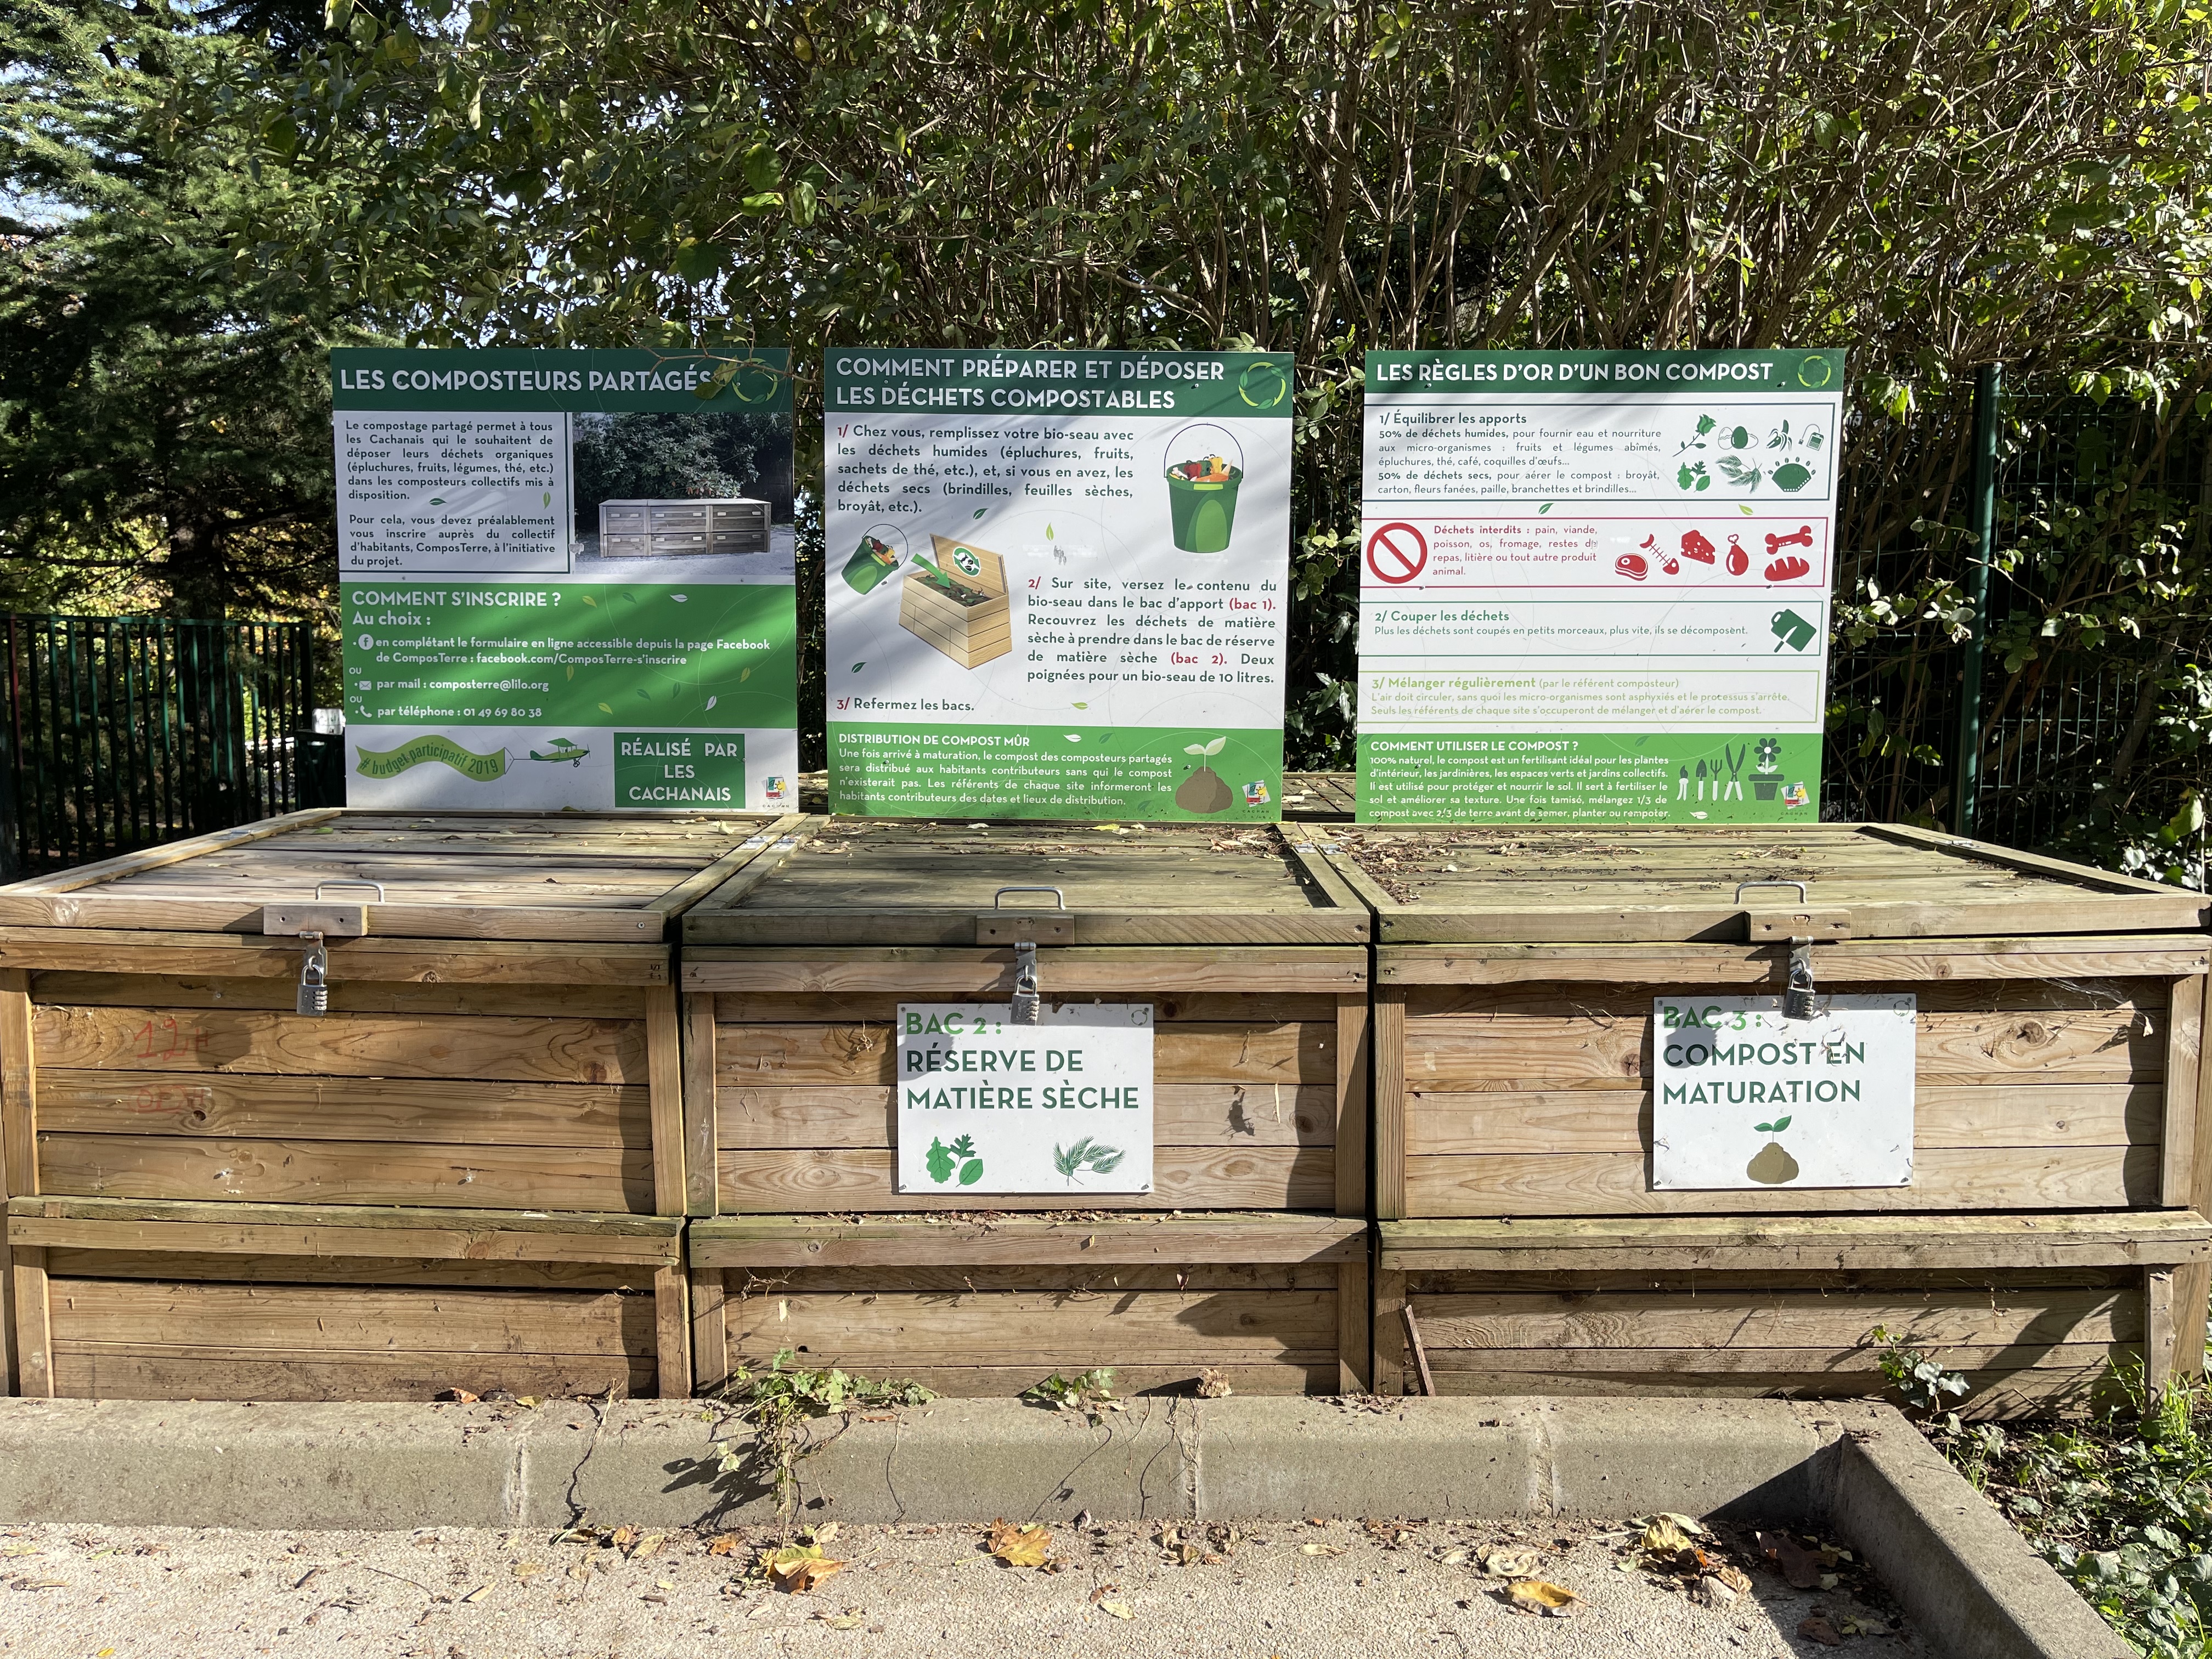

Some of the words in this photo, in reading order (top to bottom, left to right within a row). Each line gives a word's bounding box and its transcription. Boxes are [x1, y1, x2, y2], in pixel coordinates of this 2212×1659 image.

[836, 358, 955, 377] COMMENT
[963, 354, 1077, 379] PRÉPARER
[1085, 360, 1112, 379] ET
[1120, 355, 1224, 380] DÉPOSER
[1377, 364, 1413, 381] LES
[1419, 358, 1497, 381] RÈGLES
[1503, 364, 1553, 381] D'OR
[1559, 364, 1609, 381] D'UN
[1615, 364, 1660, 381] BON
[1666, 363, 1773, 380] COMPOST
[341, 370, 385, 390] LES
[392, 370, 582, 391] COMPOSTEURS
[589, 364, 712, 391] PARTAGÉS
[837, 387, 875, 405] LES
[882, 382, 985, 407] DÉCHETS
[991, 388, 1175, 409] COMPOSTABLES
[346, 420, 359, 430] Le
[363, 421, 428, 433] compostage
[432, 421, 473, 433] partagé
[477, 421, 516, 433] permet
[520, 421, 526, 431] à
[529, 421, 552, 431] tous
[1379, 412, 1390, 426] 1/
[1394, 412, 1455, 427] Équilibrer
[1459, 412, 1475, 424] les
[1479, 413, 1527, 426] apports
[346, 433, 361, 444] les
[370, 434, 424, 444] Cachanais
[432, 435, 449, 447] qui
[457, 435, 466, 444] le
[475, 435, 532, 445] souhaitent
[540, 435, 553, 445] de
[837, 424, 849, 438] 1/
[853, 424, 887, 437] Chez
[891, 430, 925, 439] vous,
[930, 426, 999, 441] remplissez
[1003, 428, 1039, 439] votre
[1044, 427, 1099, 440] bio-seau
[1379, 431, 1402, 439] 50%
[1406, 428, 1418, 438] de
[1422, 428, 1461, 438] déchets
[1465, 428, 1509, 438] humides,
[1513, 431, 1535, 440] pour
[1539, 428, 1572, 437] fournir
[1598, 429, 1607, 437] et
[1612, 428, 1661, 437] nourriture
[838, 443, 856, 455] les
[868, 443, 920, 456] déchets
[933, 444, 988, 457] humides
[1000, 445, 1081, 461] (épluchures,
[1094, 447, 1133, 461] fruits,
[838, 461, 887, 474] sachets
[892, 462, 908, 475] de
[913, 462, 939, 477] thé,
[944, 464, 978, 478] etc.),
[983, 465, 1000, 478] et,
[1006, 465, 1015, 476] si
[1076, 470, 1110, 479] avez,
[1115, 466, 1133, 478] les
[838, 480, 890, 493] déchets
[902, 486, 930, 494] secs
[943, 482, 1012, 496] (brindilles,
[1024, 483, 1072, 496] feuilles
[1085, 484, 1133, 499] sèches,
[838, 499, 884, 515] broyât,
[888, 500, 922, 514] etc.).
[1434, 524, 1474, 534] Déchets
[1480, 524, 1521, 534] interdits
[1535, 526, 1558, 536] pain,
[1564, 524, 1597, 534] viande,
[1028, 576, 1041, 590] 2/
[1051, 577, 1074, 589] Sur
[1084, 578, 1111, 591] site,
[1175, 578, 1187, 590] le
[1197, 580, 1250, 591] contenu
[1261, 579, 1277, 591] du
[352, 590, 447, 606] COMMENT
[452, 591, 547, 606] S'INSCRIRE
[352, 611, 374, 625] Au
[379, 610, 422, 625] choix
[1375, 610, 1387, 623] 2/
[1391, 611, 1437, 624] Couper
[1441, 610, 1457, 621] les
[1460, 610, 1509, 621] déchets
[377, 681, 395, 691] par
[398, 678, 420, 689] mail
[429, 679, 549, 692] composterre@lilo.org
[1372, 676, 1385, 690] 3/
[1389, 676, 1446, 691] Mélanger
[1449, 676, 1536, 691] régulièrement
[1539, 678, 1559, 690] (par
[1562, 678, 1570, 687] le
[1573, 678, 1614, 687] référent
[1617, 678, 1679, 690] composteur)
[377, 709, 396, 718] par
[398, 705, 454, 719] téléphone
[463, 708, 475, 716] 01
[478, 708, 492, 718] 49
[494, 707, 508, 718] 69
[511, 708, 526, 716] 80
[528, 708, 542, 718] 38
[837, 697, 850, 710] 3/
[854, 697, 917, 710] Refermez
[921, 698, 938, 710] les
[942, 698, 974, 711] bacs.
[622, 737, 691, 757] RÉALISÉ
[705, 743, 737, 757] PAR
[839, 733, 920, 744] DISTRIBUTION
[923, 735, 939, 745] DE
[941, 735, 1001, 746] COMPOST
[1004, 733, 1030, 747] MÛR
[1370, 741, 1434, 751] COMMENT
[1436, 741, 1488, 751] UTILISER
[1491, 741, 1505, 751] LE
[1508, 741, 1570, 751] COMPOST
[409, 742, 469, 768] participatif
[467, 758, 499, 775] 2019
[664, 764, 695, 778] LES
[629, 786, 731, 801] CACHANAIS
[906, 1012, 964, 1035] BAC
[973, 1017, 986, 1035] 2
[1663, 1006, 1722, 1029] BAC
[1731, 1010, 1747, 1031] 3
[907, 1042, 1036, 1072] RÉSERVE
[1046, 1049, 1083, 1073] DE
[1663, 1042, 1816, 1066] COMPOST
[1826, 1042, 1865, 1064] EN
[907, 1079, 1032, 1109] MATIÈRE
[1041, 1079, 1139, 1109] SÈCHE
[1663, 1080, 1860, 1105] MATURATION
